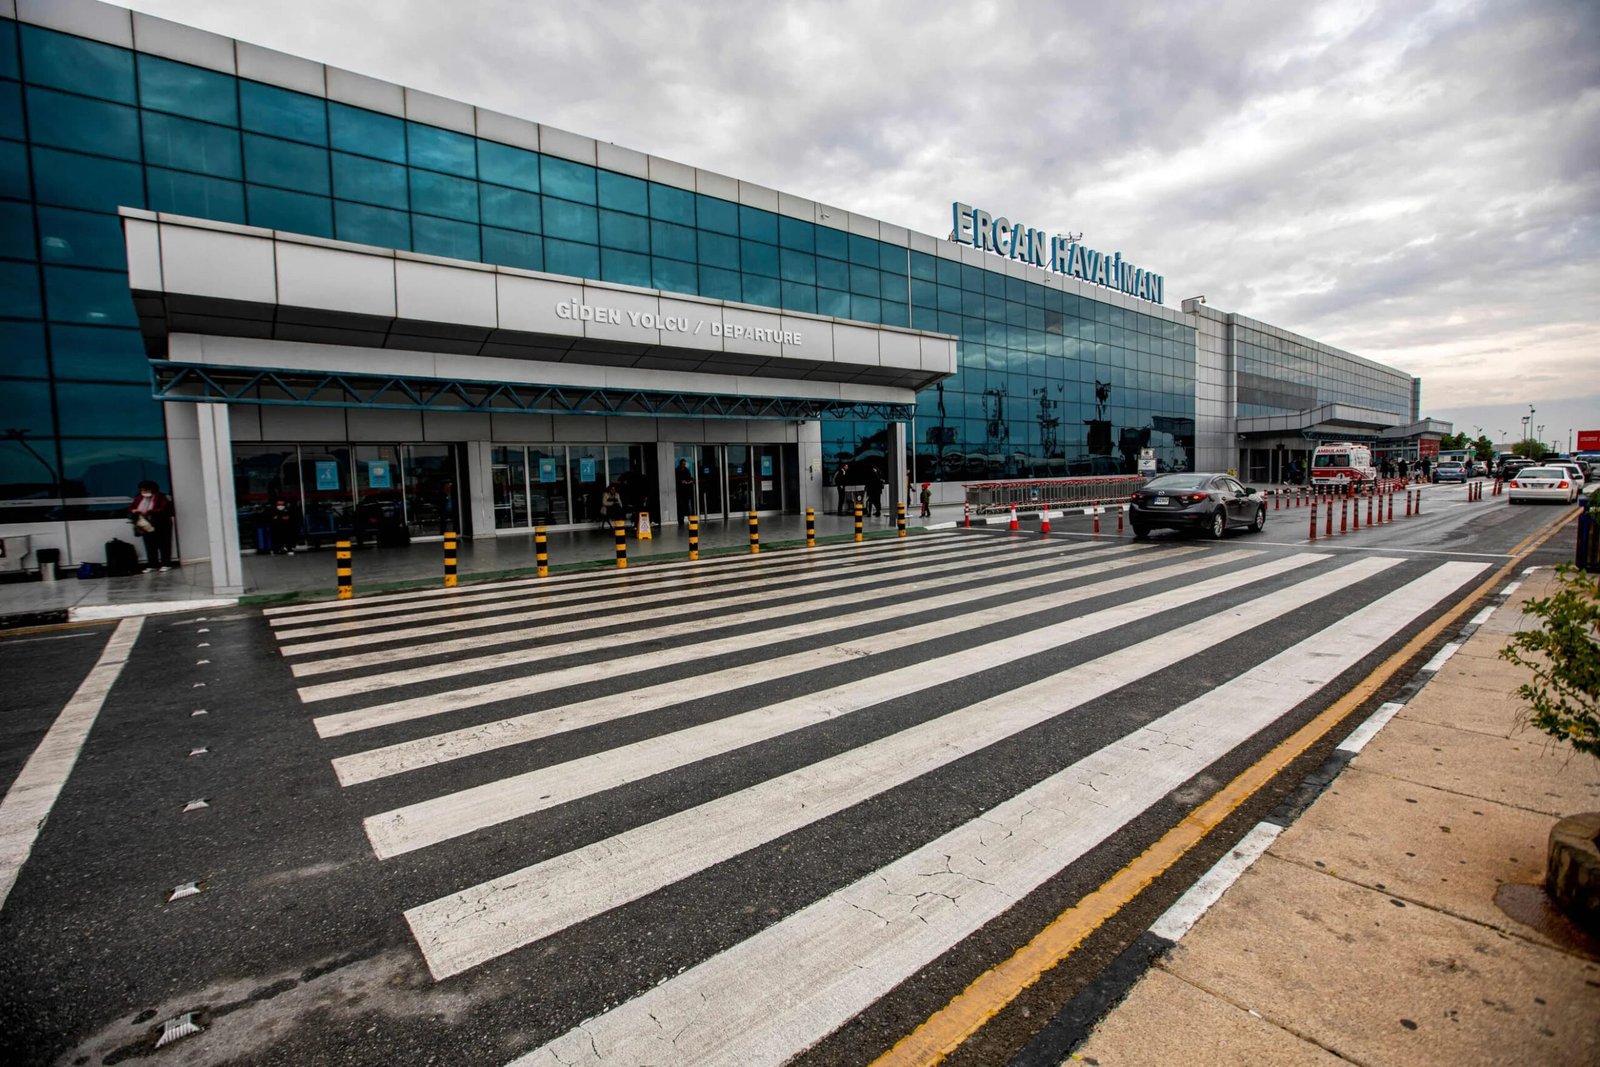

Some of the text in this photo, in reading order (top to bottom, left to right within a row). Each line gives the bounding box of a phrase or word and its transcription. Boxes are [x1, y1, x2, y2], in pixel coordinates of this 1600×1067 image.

[952, 202, 1164, 304] ERCAN HAVALİMANI
[627, 310, 689, 332] YOLCU
[710, 321, 802, 345] DEPARTURE
